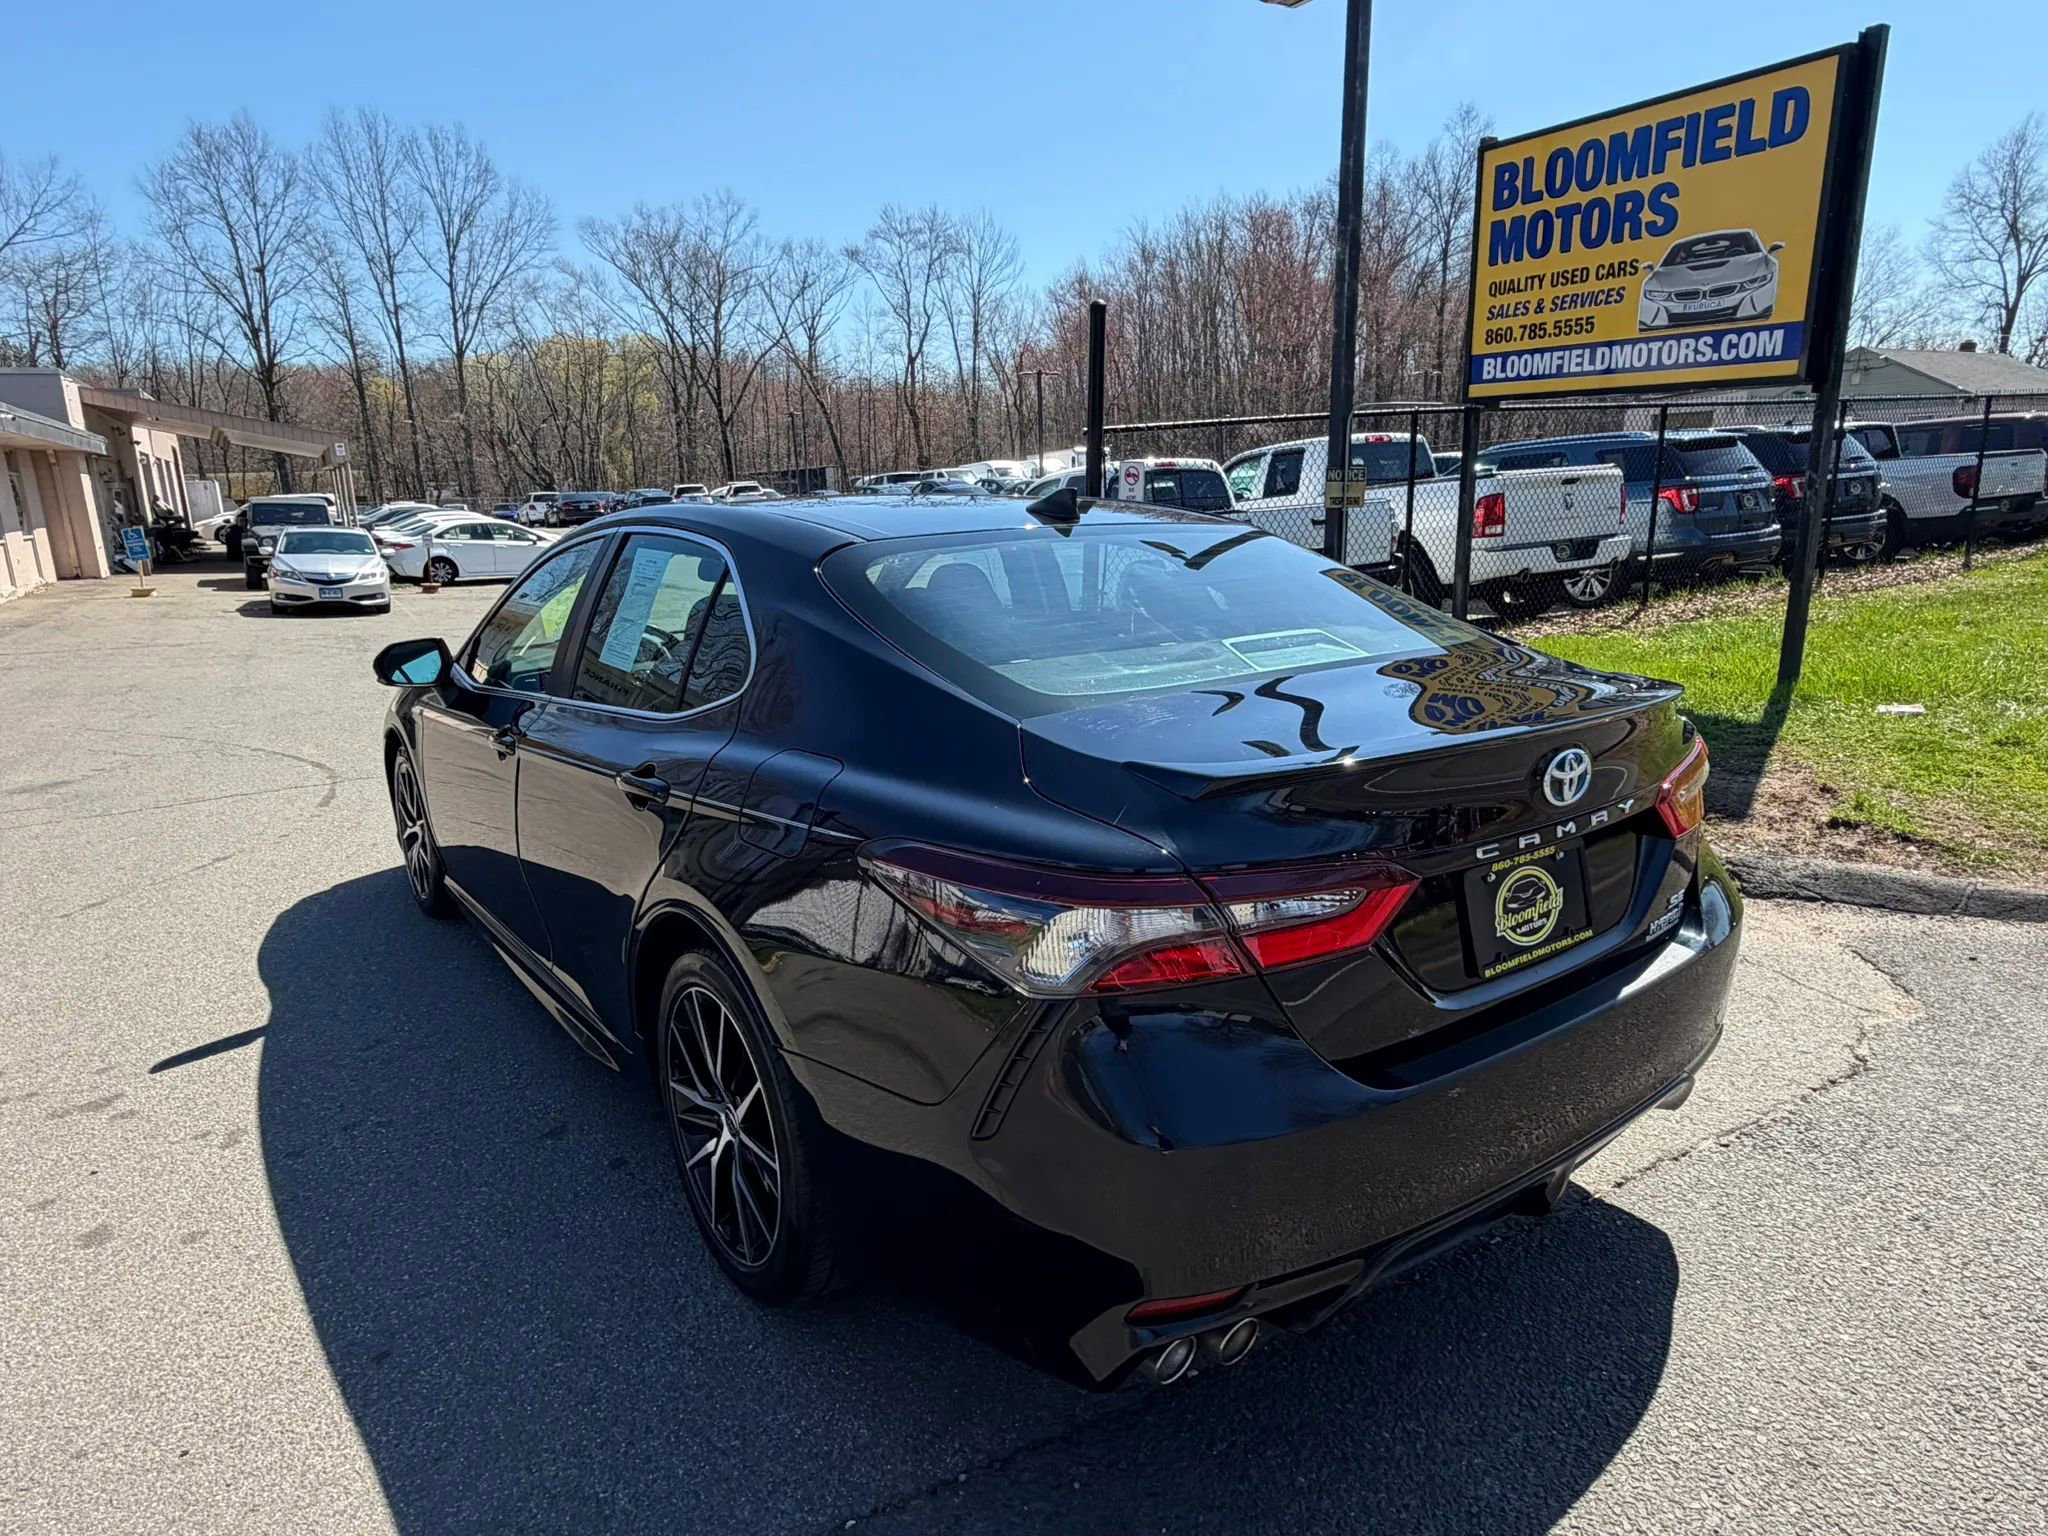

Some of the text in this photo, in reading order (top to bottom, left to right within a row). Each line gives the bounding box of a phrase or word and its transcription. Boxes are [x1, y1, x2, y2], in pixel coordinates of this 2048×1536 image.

[1492, 85, 1811, 212] BLOOMFIELD
[1487, 181, 1681, 267] MOTORS
[1488, 258, 1640, 298] QUALITY USED CARS
[1486, 286, 1626, 321] SALES & SERVICES
[1485, 316, 1596, 346] 860.785.5555
[1482, 329, 1785, 381] BLOOMFIELDMOTORS.COM
[1328, 470, 1365, 481] NOICE
[1476, 799, 1635, 860] CAMRY
[1491, 846, 1556, 872] 860-785-5555
[1499, 894, 1561, 930] Bloomfield
[1516, 917, 1548, 934] MOTORS
[1484, 929, 1594, 978] BLOOMFIELDMOTORS.COM
